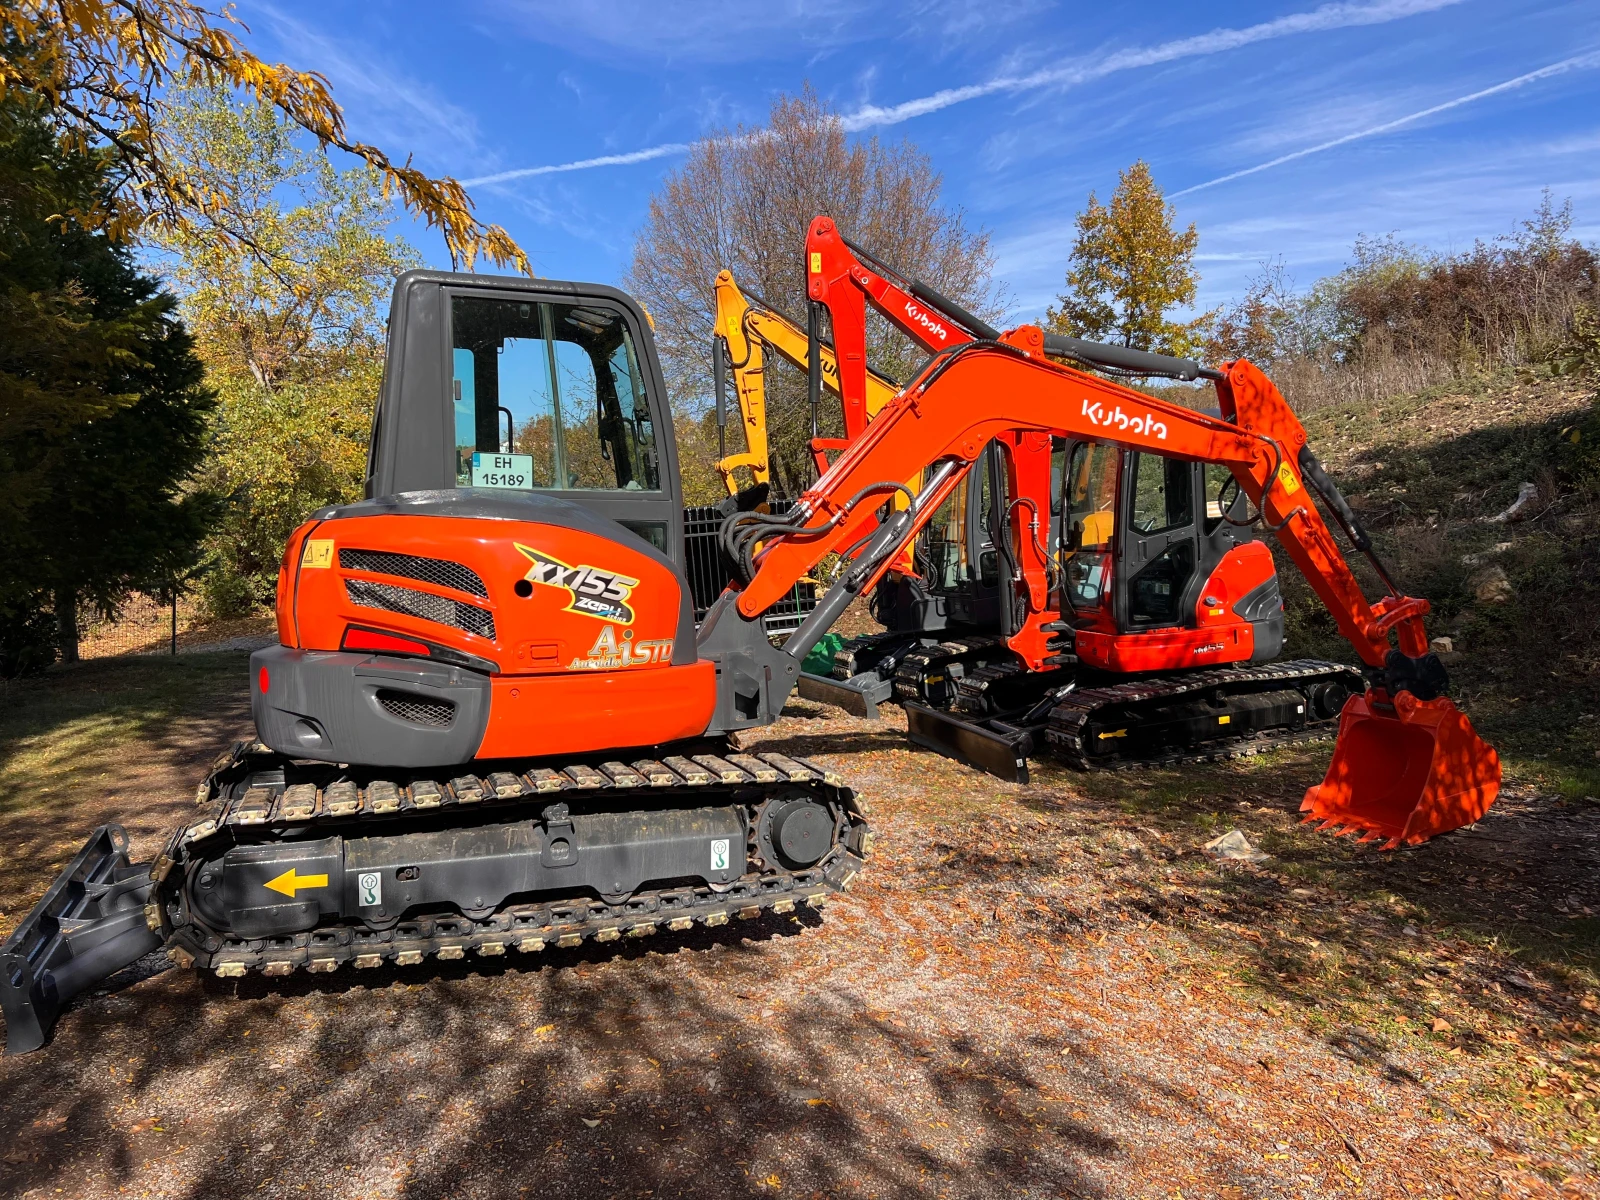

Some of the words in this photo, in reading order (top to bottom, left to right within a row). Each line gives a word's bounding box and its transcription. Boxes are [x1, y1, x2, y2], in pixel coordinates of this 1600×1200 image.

[905, 302, 947, 340] Kubota
[1081, 399, 1167, 439] Kubota
[482, 473, 525, 486] 15189
[494, 457, 512, 469] EH
[524, 561, 638, 601] KX155
